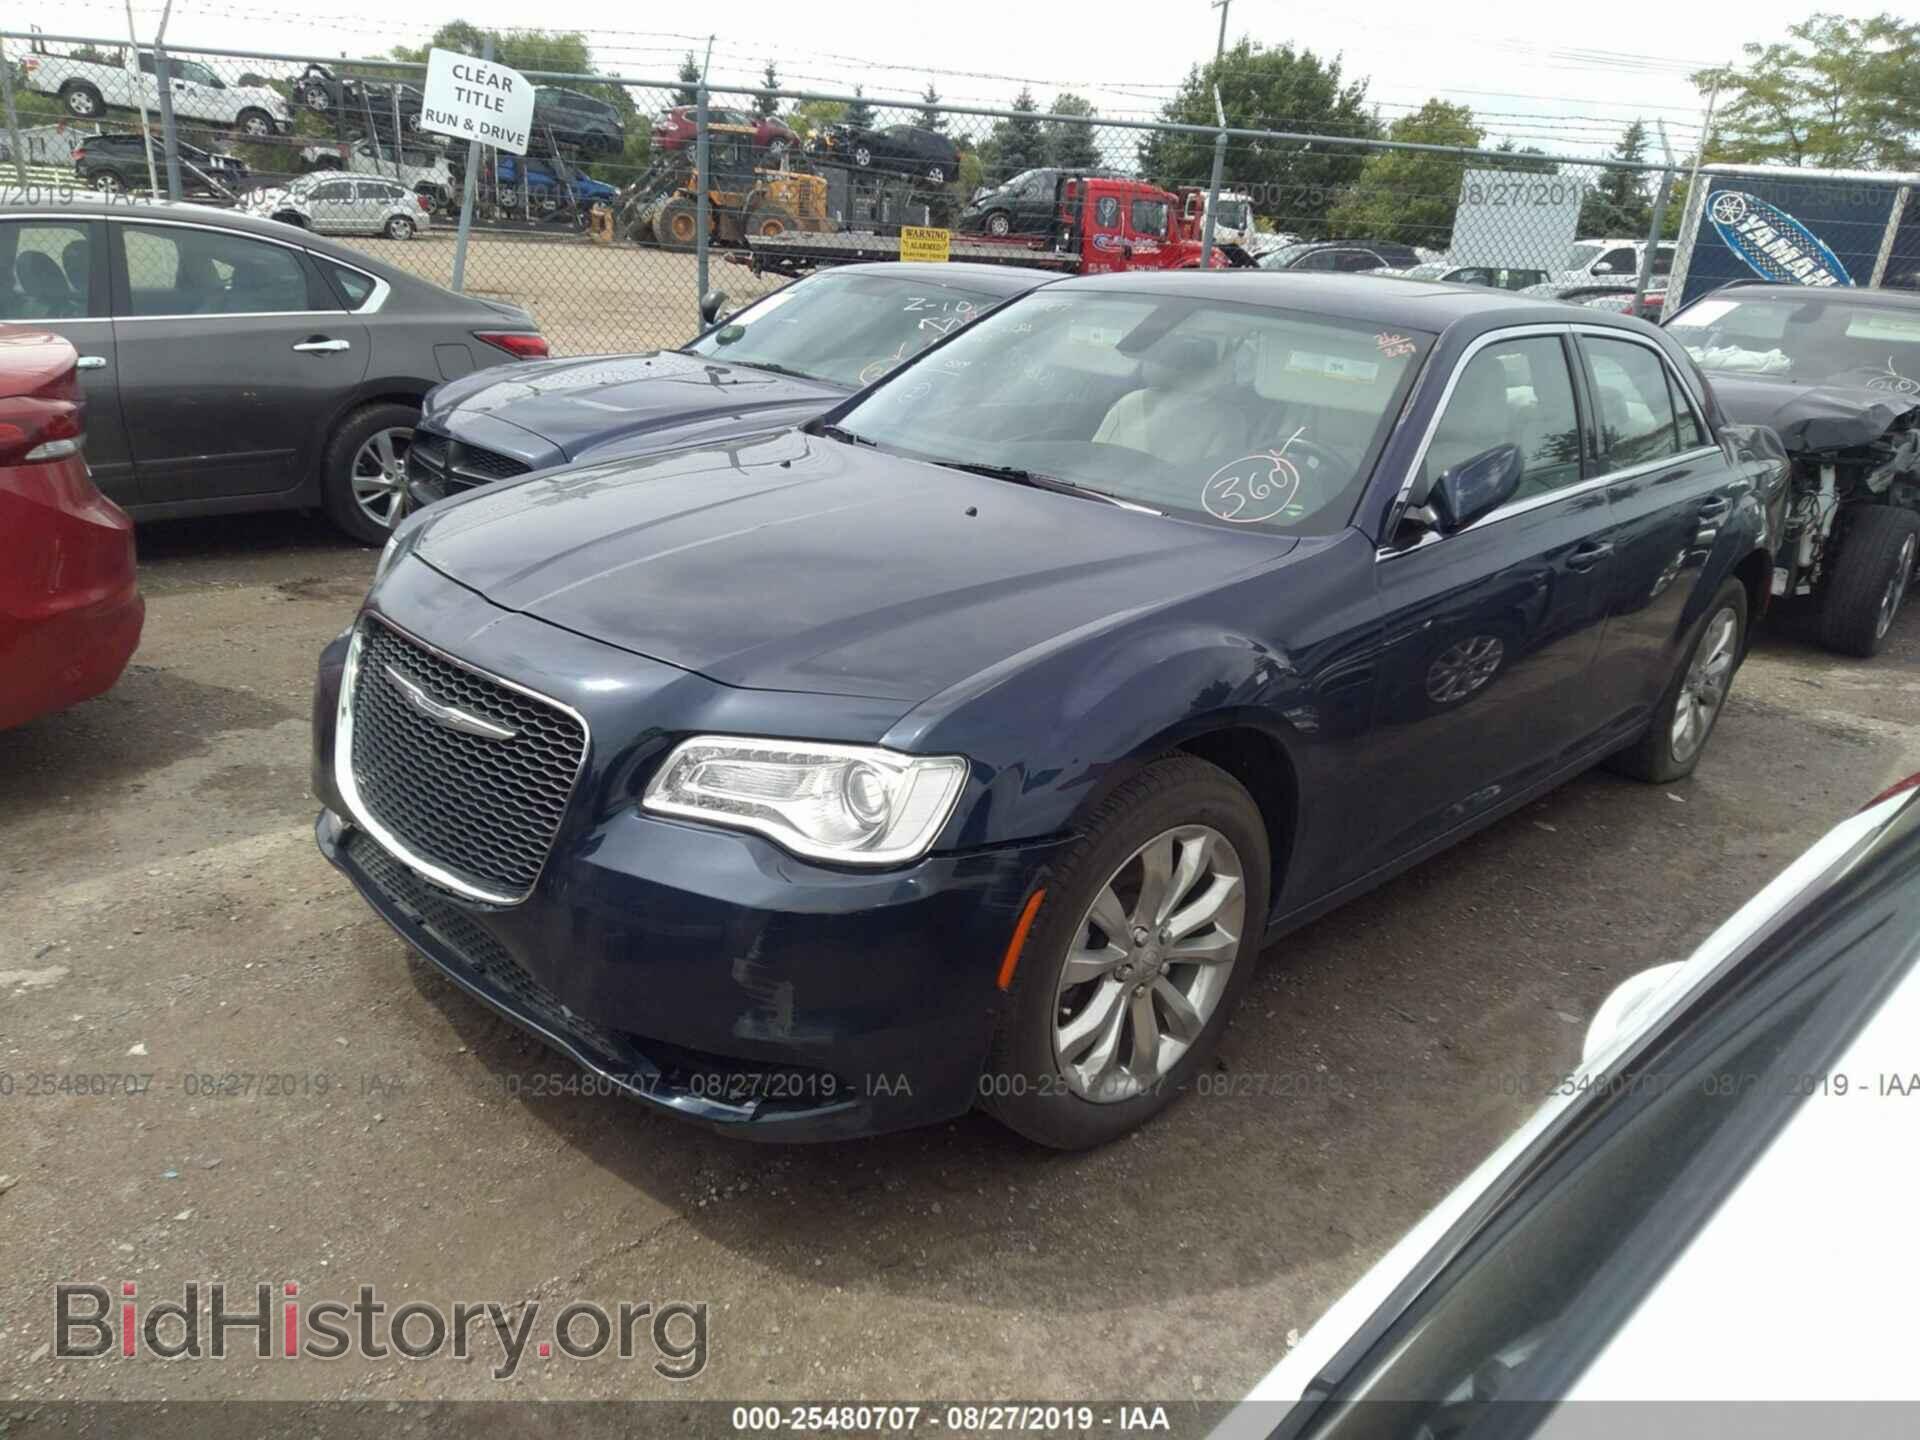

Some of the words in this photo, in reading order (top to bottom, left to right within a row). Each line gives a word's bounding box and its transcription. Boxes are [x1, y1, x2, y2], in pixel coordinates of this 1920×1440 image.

[452, 65, 512, 92] CLEAR
[455, 86, 504, 112] TITLE
[425, 109, 458, 127] RUN
[463, 118, 473, 131] &
[480, 122, 525, 146] DRIVE
[905, 229, 947, 240] WARNING
[1736, 214, 1838, 287] YAMAH
